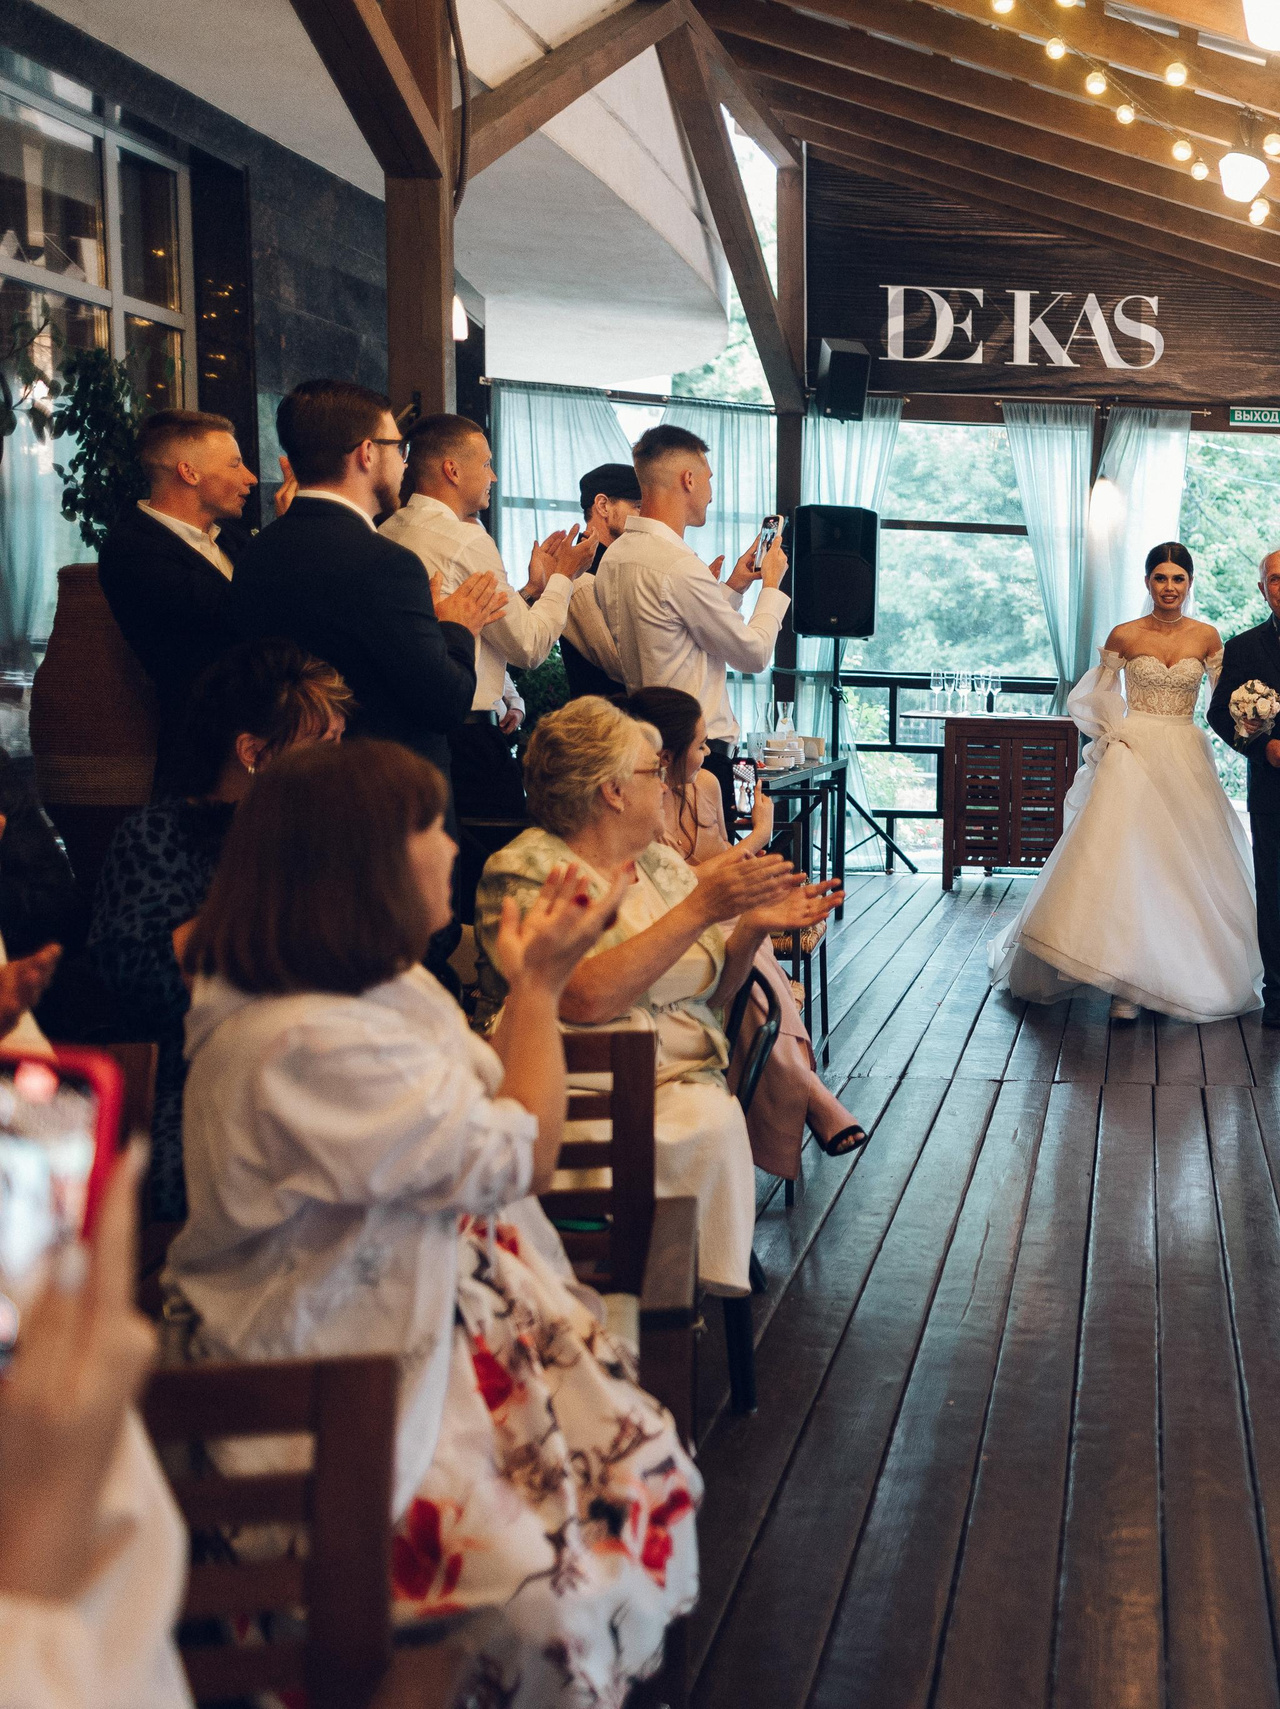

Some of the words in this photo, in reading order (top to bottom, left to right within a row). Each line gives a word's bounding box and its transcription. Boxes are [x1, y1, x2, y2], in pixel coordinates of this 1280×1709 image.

[879, 285, 983, 364] DE
[1004, 289, 1165, 370] KAS
[1234, 410, 1280, 423] ВЫХОД
